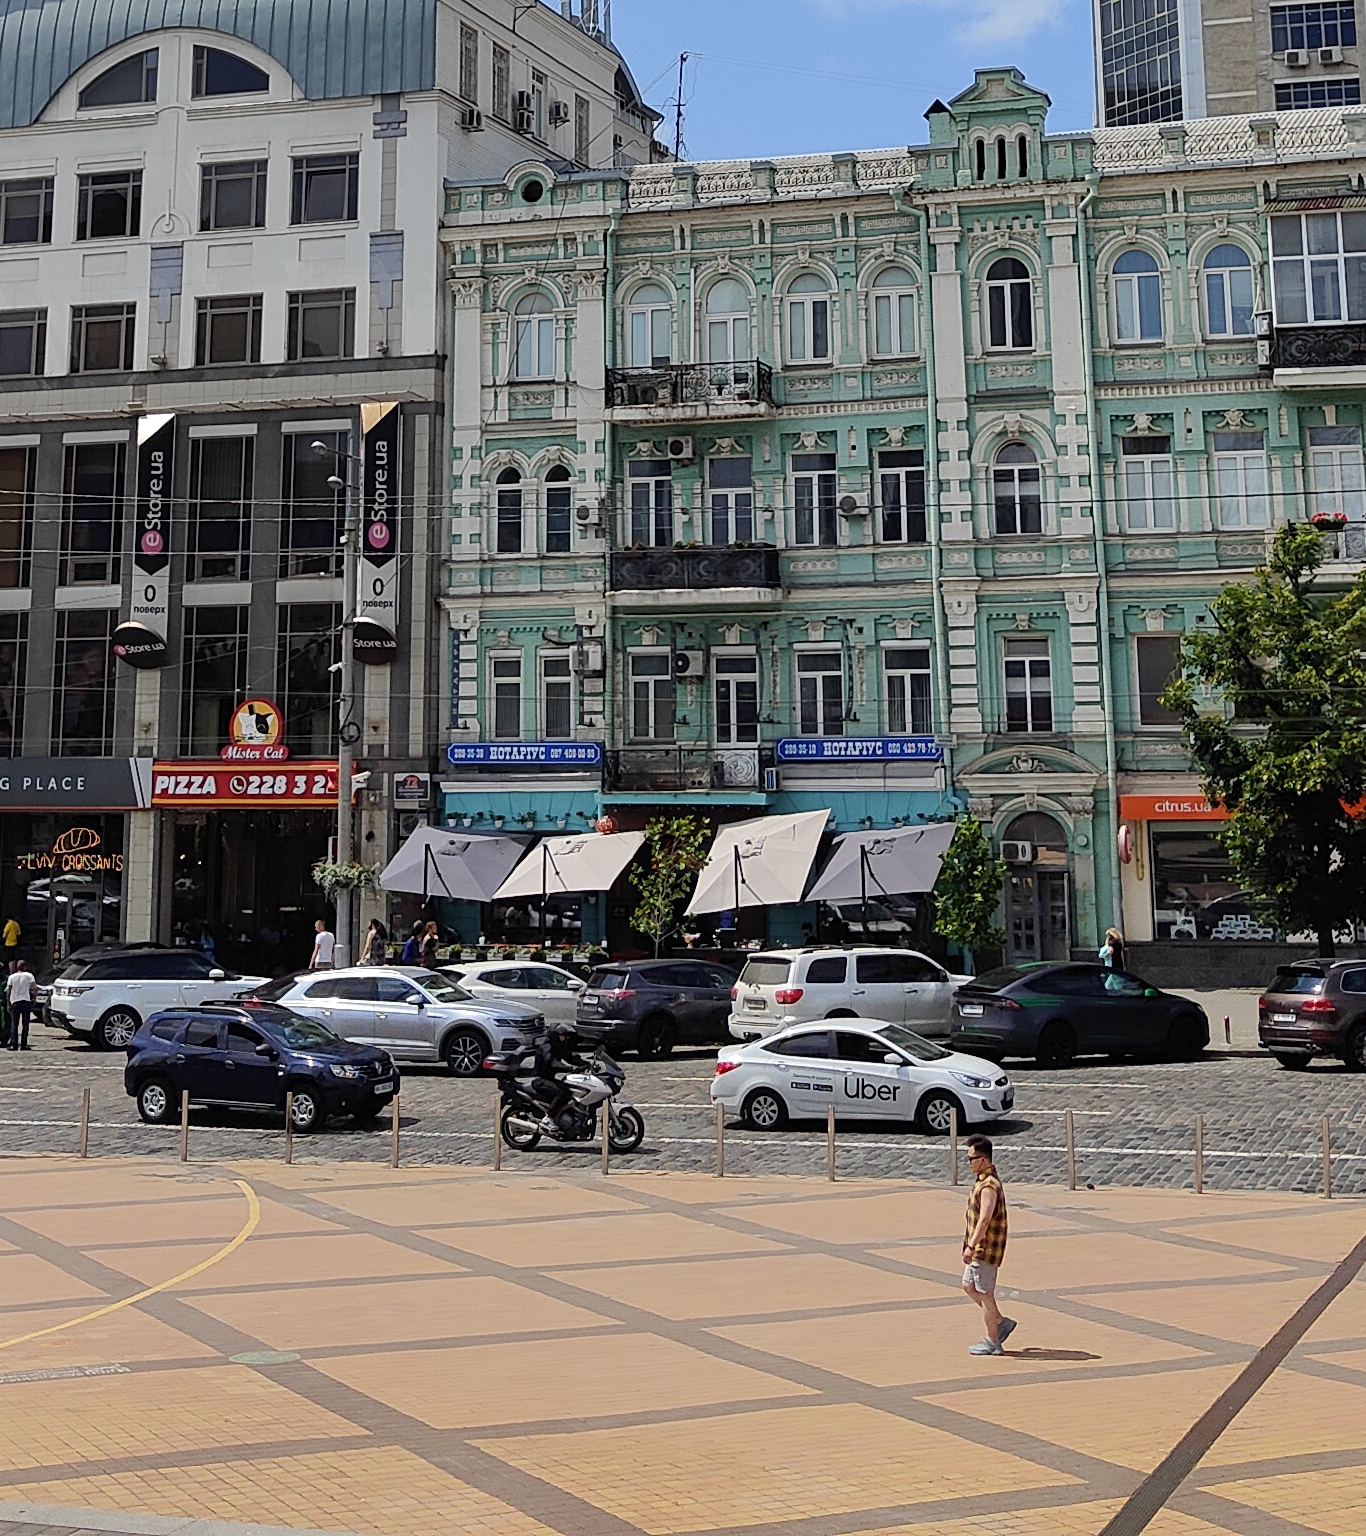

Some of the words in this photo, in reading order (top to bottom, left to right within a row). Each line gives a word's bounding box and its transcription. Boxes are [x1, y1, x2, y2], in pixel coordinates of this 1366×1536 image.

[371, 441, 388, 539] eStore.ua
[145, 451, 164, 546] eStore.ua
[144, 585, 156, 602] 0
[373, 578, 384, 596] 0
[134, 606, 165, 615] поверх
[362, 600, 393, 609] поверх
[353, 639, 397, 649] Store.ua
[222, 746, 261, 760] Mister
[263, 746, 284, 759] Cat
[489, 746, 546, 760] НОТАРІУС
[823, 741, 883, 756] НОТАРІУС
[22, 776, 86, 791] PLACE
[154, 775, 217, 795] PIZZA
[246, 775, 288, 795] 228
[292, 775, 307, 795] 3
[312, 775, 338, 795] 2
[1154, 800, 1212, 813] citrus.ua
[843, 1076, 901, 1102] Uber
